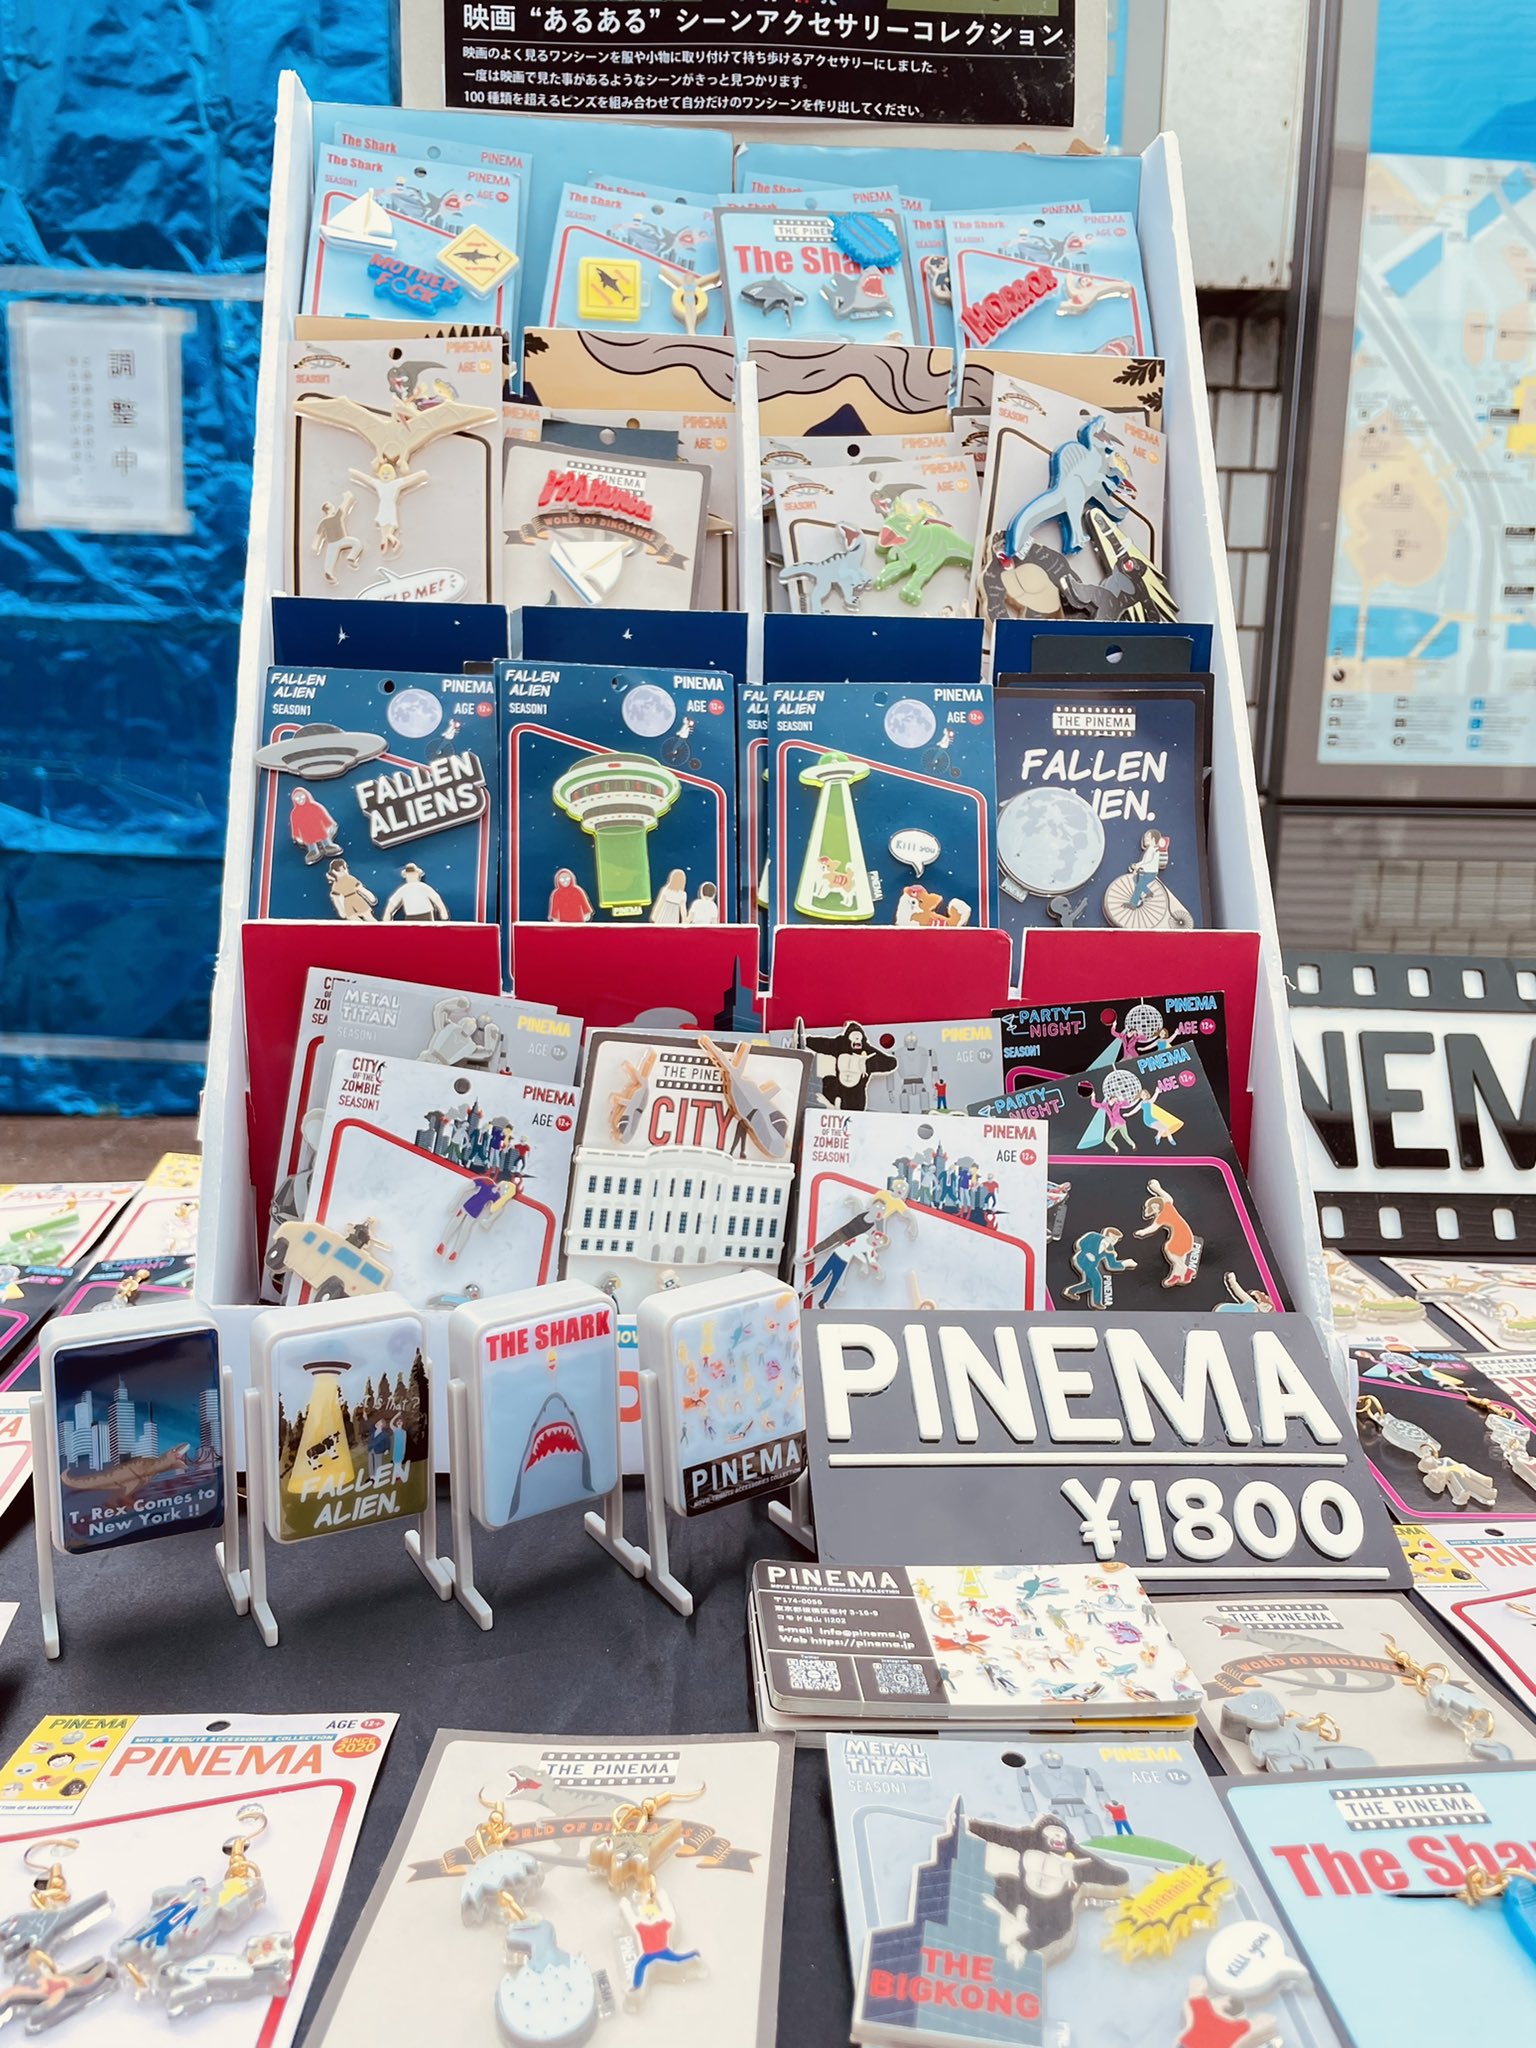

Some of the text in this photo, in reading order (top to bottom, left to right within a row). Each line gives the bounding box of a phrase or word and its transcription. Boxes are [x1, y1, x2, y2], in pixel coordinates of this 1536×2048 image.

[327, 153, 384, 173] The Shark
[467, 171, 511, 187] PINEMA
[733, 245, 793, 274] The
[368, 252, 459, 293] MOTHER
[961, 266, 1059, 346] HORROR
[583, 515, 599, 526] OF
[270, 672, 327, 687] FALLEN
[504, 669, 560, 684] FALLEN
[673, 675, 725, 692] PINEMA
[273, 686, 317, 700] ALIEN
[442, 678, 494, 695] PINEMA
[509, 683, 551, 698] ALIEN
[933, 687, 984, 703] PINEMA
[773, 689, 825, 702] FALLEN
[272, 702, 312, 716] SEASON1
[454, 702, 475, 715] AGE
[508, 702, 548, 715] SEASON1
[686, 699, 708, 713] AGE
[777, 703, 817, 715] ALIEN
[776, 720, 813, 732] SEASON1
[946, 711, 967, 724] AGE
[1057, 715, 1131, 728] THE PINEMA
[1020, 748, 1168, 783] FALLEN
[356, 751, 478, 812] FALLEN
[370, 782, 481, 840] ALIENS
[342, 988, 400, 1008] METAL
[1165, 995, 1218, 1013] PINEMA
[341, 1005, 398, 1029] TITAN
[1018, 1006, 1072, 1024] PARTY
[517, 1014, 572, 1039] PINEMA
[941, 1026, 993, 1043] PINEMA
[1029, 1019, 1082, 1039] NIGHT
[1177, 1020, 1198, 1035] AGE
[527, 1042, 549, 1057] AGE
[956, 1050, 975, 1063] AGE
[1003, 1045, 1041, 1059] SEASON1
[351, 1056, 380, 1073] CITY
[1137, 1046, 1192, 1075] PINEMA
[352, 1071, 375, 1081] OF THE
[662, 1065, 725, 1082] THE PINE
[341, 1079, 382, 1097] ZOMBIE
[1157, 1075, 1180, 1094] AGE
[338, 1095, 380, 1112] SEASON1
[523, 1084, 576, 1107] PINEMA
[994, 1087, 1047, 1111] PARTY
[531, 1113, 571, 1129] AGE 12+
[648, 1096, 735, 1151] CITY
[819, 1114, 844, 1129] CITY
[982, 1123, 1037, 1141] PINEMA
[813, 1135, 849, 1150] ZOMBIE
[811, 1149, 850, 1164] SEASON1
[995, 1149, 1036, 1163] AGE 12+
[485, 1332, 530, 1362] THE
[534, 1308, 612, 1350] SHARK
[817, 1322, 1344, 1446] PINEMA
[691, 1439, 801, 1499] PINEMA
[300, 1459, 411, 1503] FALLEN
[69, 1487, 216, 1526] T. Rex Comes to
[313, 1490, 401, 1529] ALIEN.
[88, 1507, 183, 1537] New York
[1059, 1476, 1365, 1561] ¥1800
[767, 1566, 899, 1590] PINEMA
[1228, 1609, 1332, 1623] THE PINEMA
[777, 1624, 814, 1635] E-mail
[778, 1634, 809, 1645] Web
[1235, 1655, 1287, 1673] WORLD
[1289, 1655, 1309, 1667] OF
[48, 1718, 129, 1730] PINEMA
[325, 1719, 358, 1730] AGE
[133, 1736, 166, 1744] MOVIE
[167, 1735, 208, 1743] TRIBUTE
[275, 1733, 335, 1742] COLLECTION
[341, 1736, 376, 1745] SINCE
[335, 1742, 377, 1754] 2020
[842, 1738, 927, 1759] METAL
[1098, 1746, 1184, 1765] PINEMA
[110, 1743, 323, 1777] PINEMA
[845, 1757, 932, 1778] TITAN
[546, 1762, 670, 1776] THE PINEMA
[1130, 1769, 1189, 1785] AGE 12+
[1344, 1796, 1476, 1818] THE PINEMA
[562, 1820, 588, 1835] OF
[1269, 1842, 1411, 1898] The
[919, 1945, 995, 1983] THE
[868, 1968, 1042, 2020] BIGKONG
